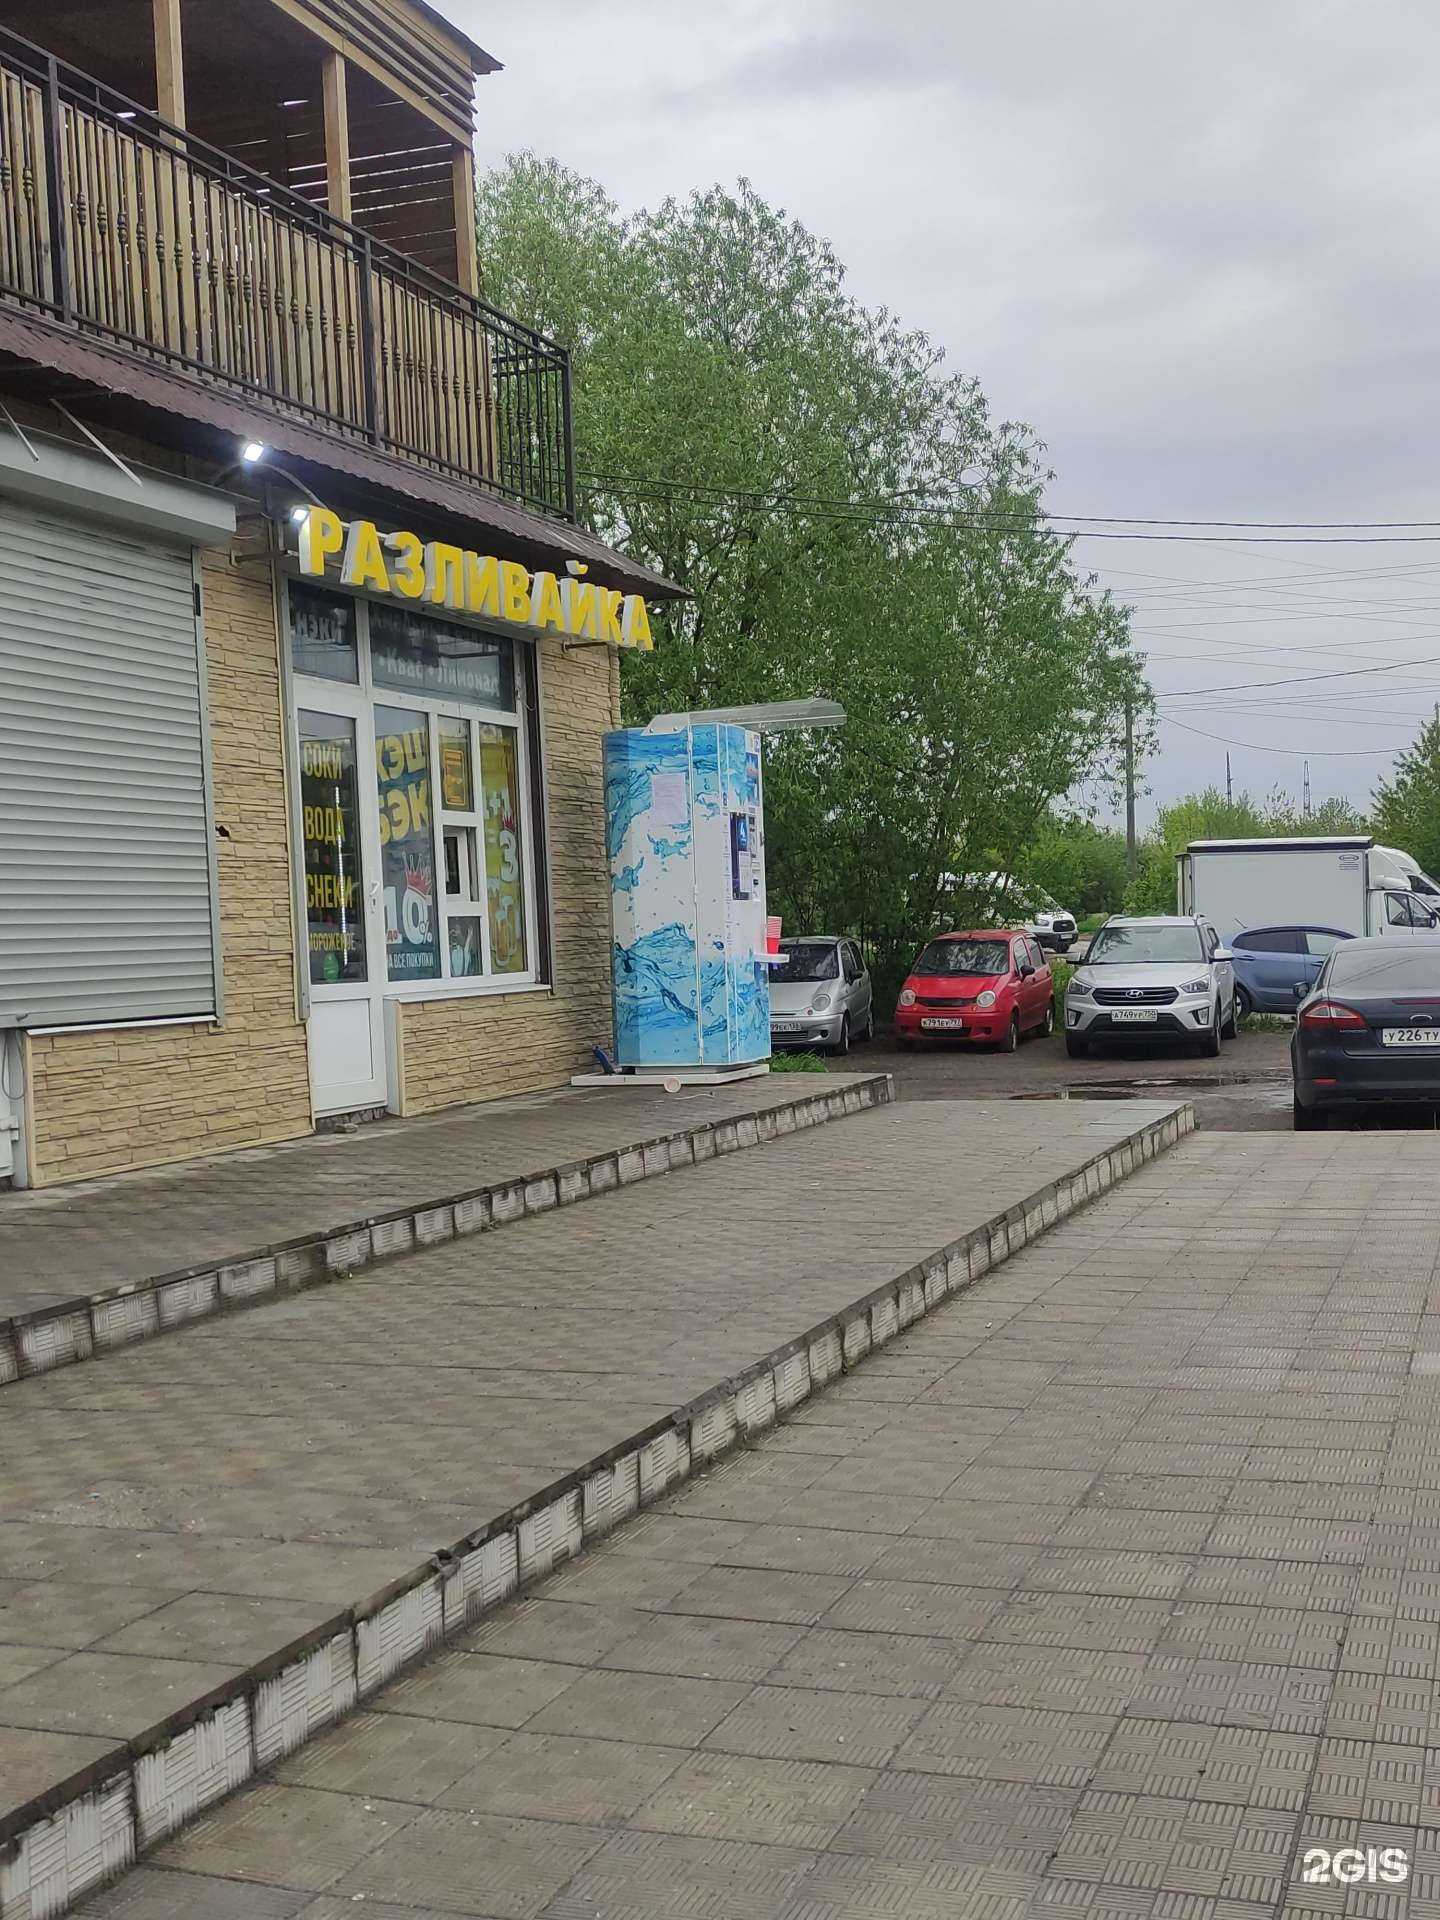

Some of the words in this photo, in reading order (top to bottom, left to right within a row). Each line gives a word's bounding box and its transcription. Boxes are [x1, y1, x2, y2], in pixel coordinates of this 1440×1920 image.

[299, 505, 653, 650] РАЗЛИВАЙКА
[304, 743, 342, 780] СОКИ
[304, 806, 346, 847] ВОДА
[306, 874, 353, 909] СНЕКИ
